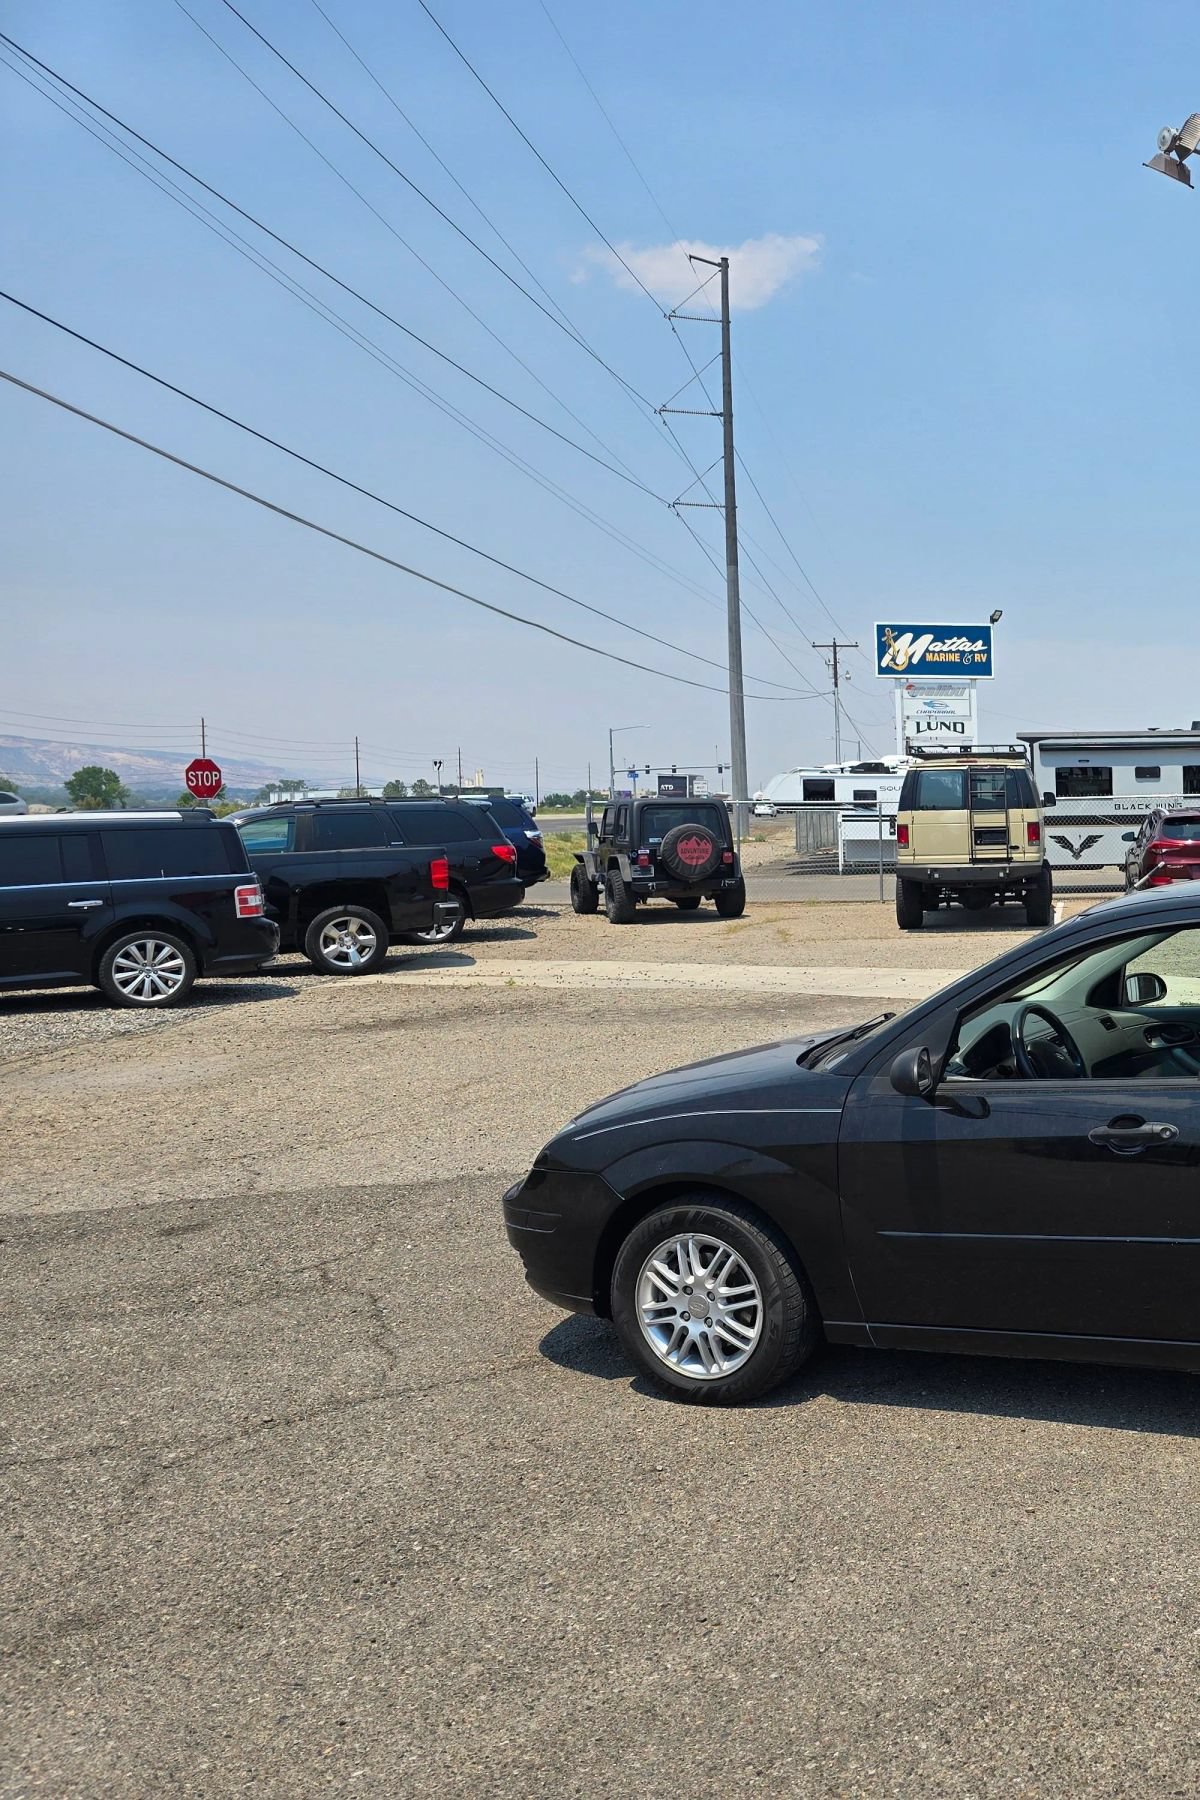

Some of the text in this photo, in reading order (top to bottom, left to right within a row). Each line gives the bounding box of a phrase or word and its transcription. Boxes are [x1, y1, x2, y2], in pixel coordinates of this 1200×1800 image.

[880, 632, 988, 668] Mattas
[925, 652, 988, 665] MARINE & RV
[915, 721, 965, 735] LUND
[188, 771, 220, 787] STOP
[1114, 803, 1152, 811] BLACK
